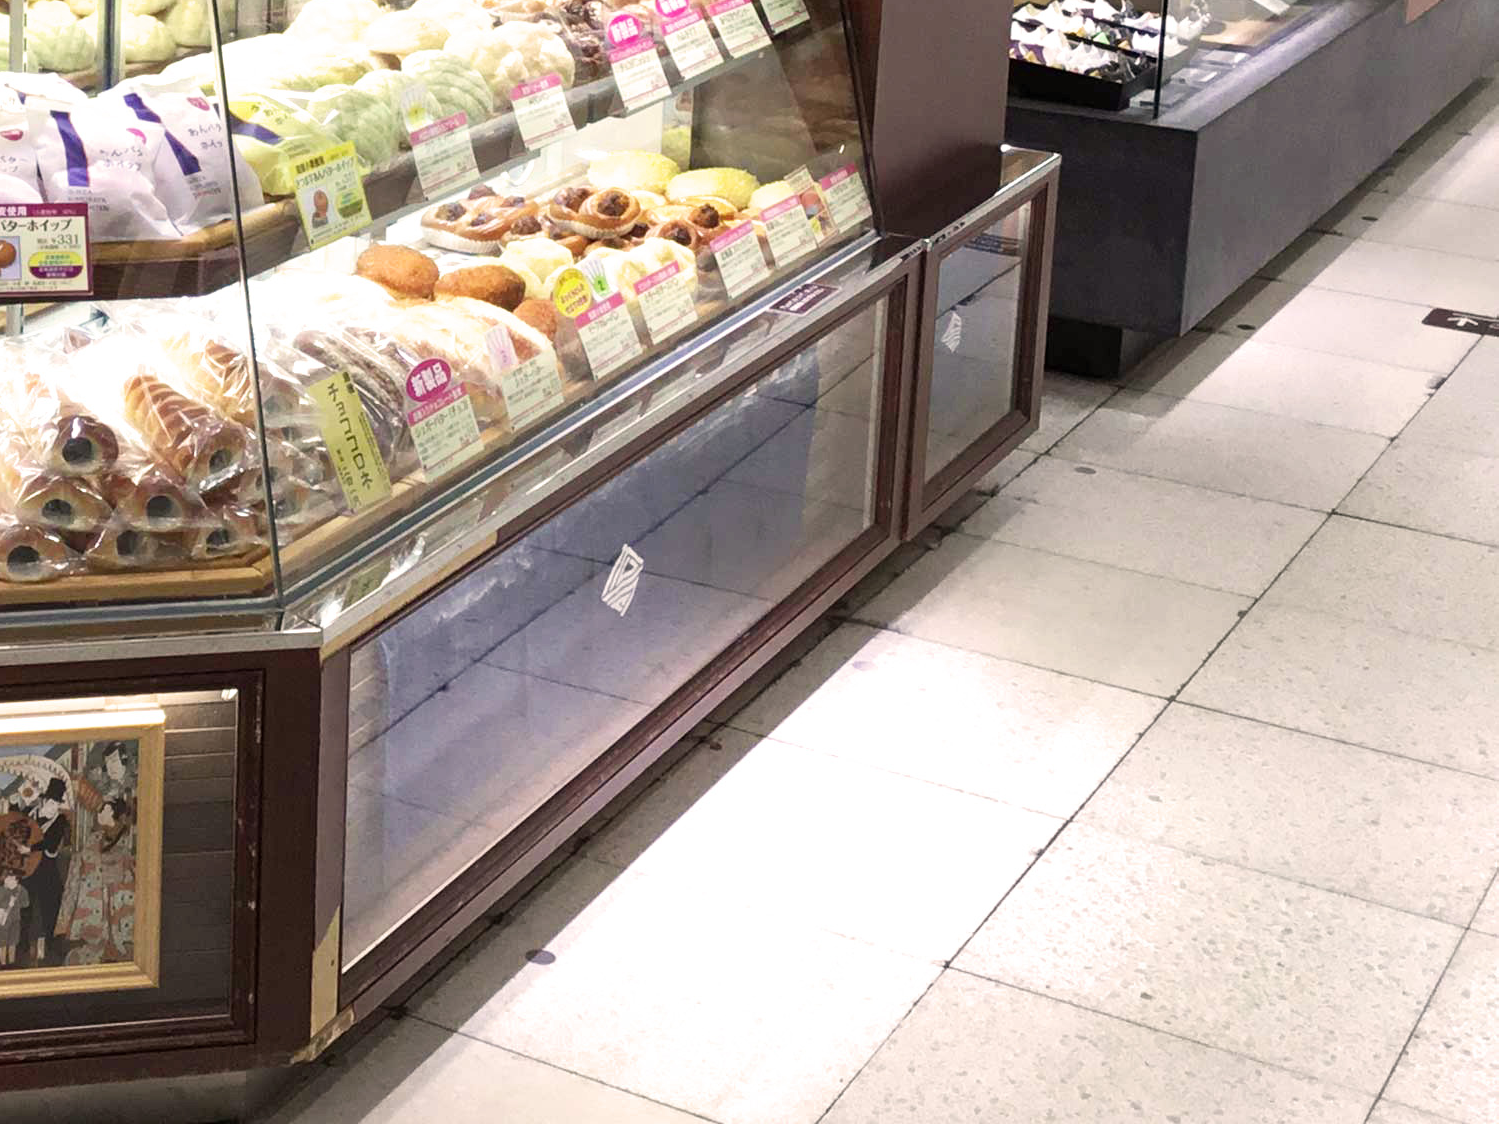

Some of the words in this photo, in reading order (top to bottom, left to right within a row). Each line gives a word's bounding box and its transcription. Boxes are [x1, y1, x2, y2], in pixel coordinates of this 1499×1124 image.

[326, 382, 374, 490] チョココロネ
